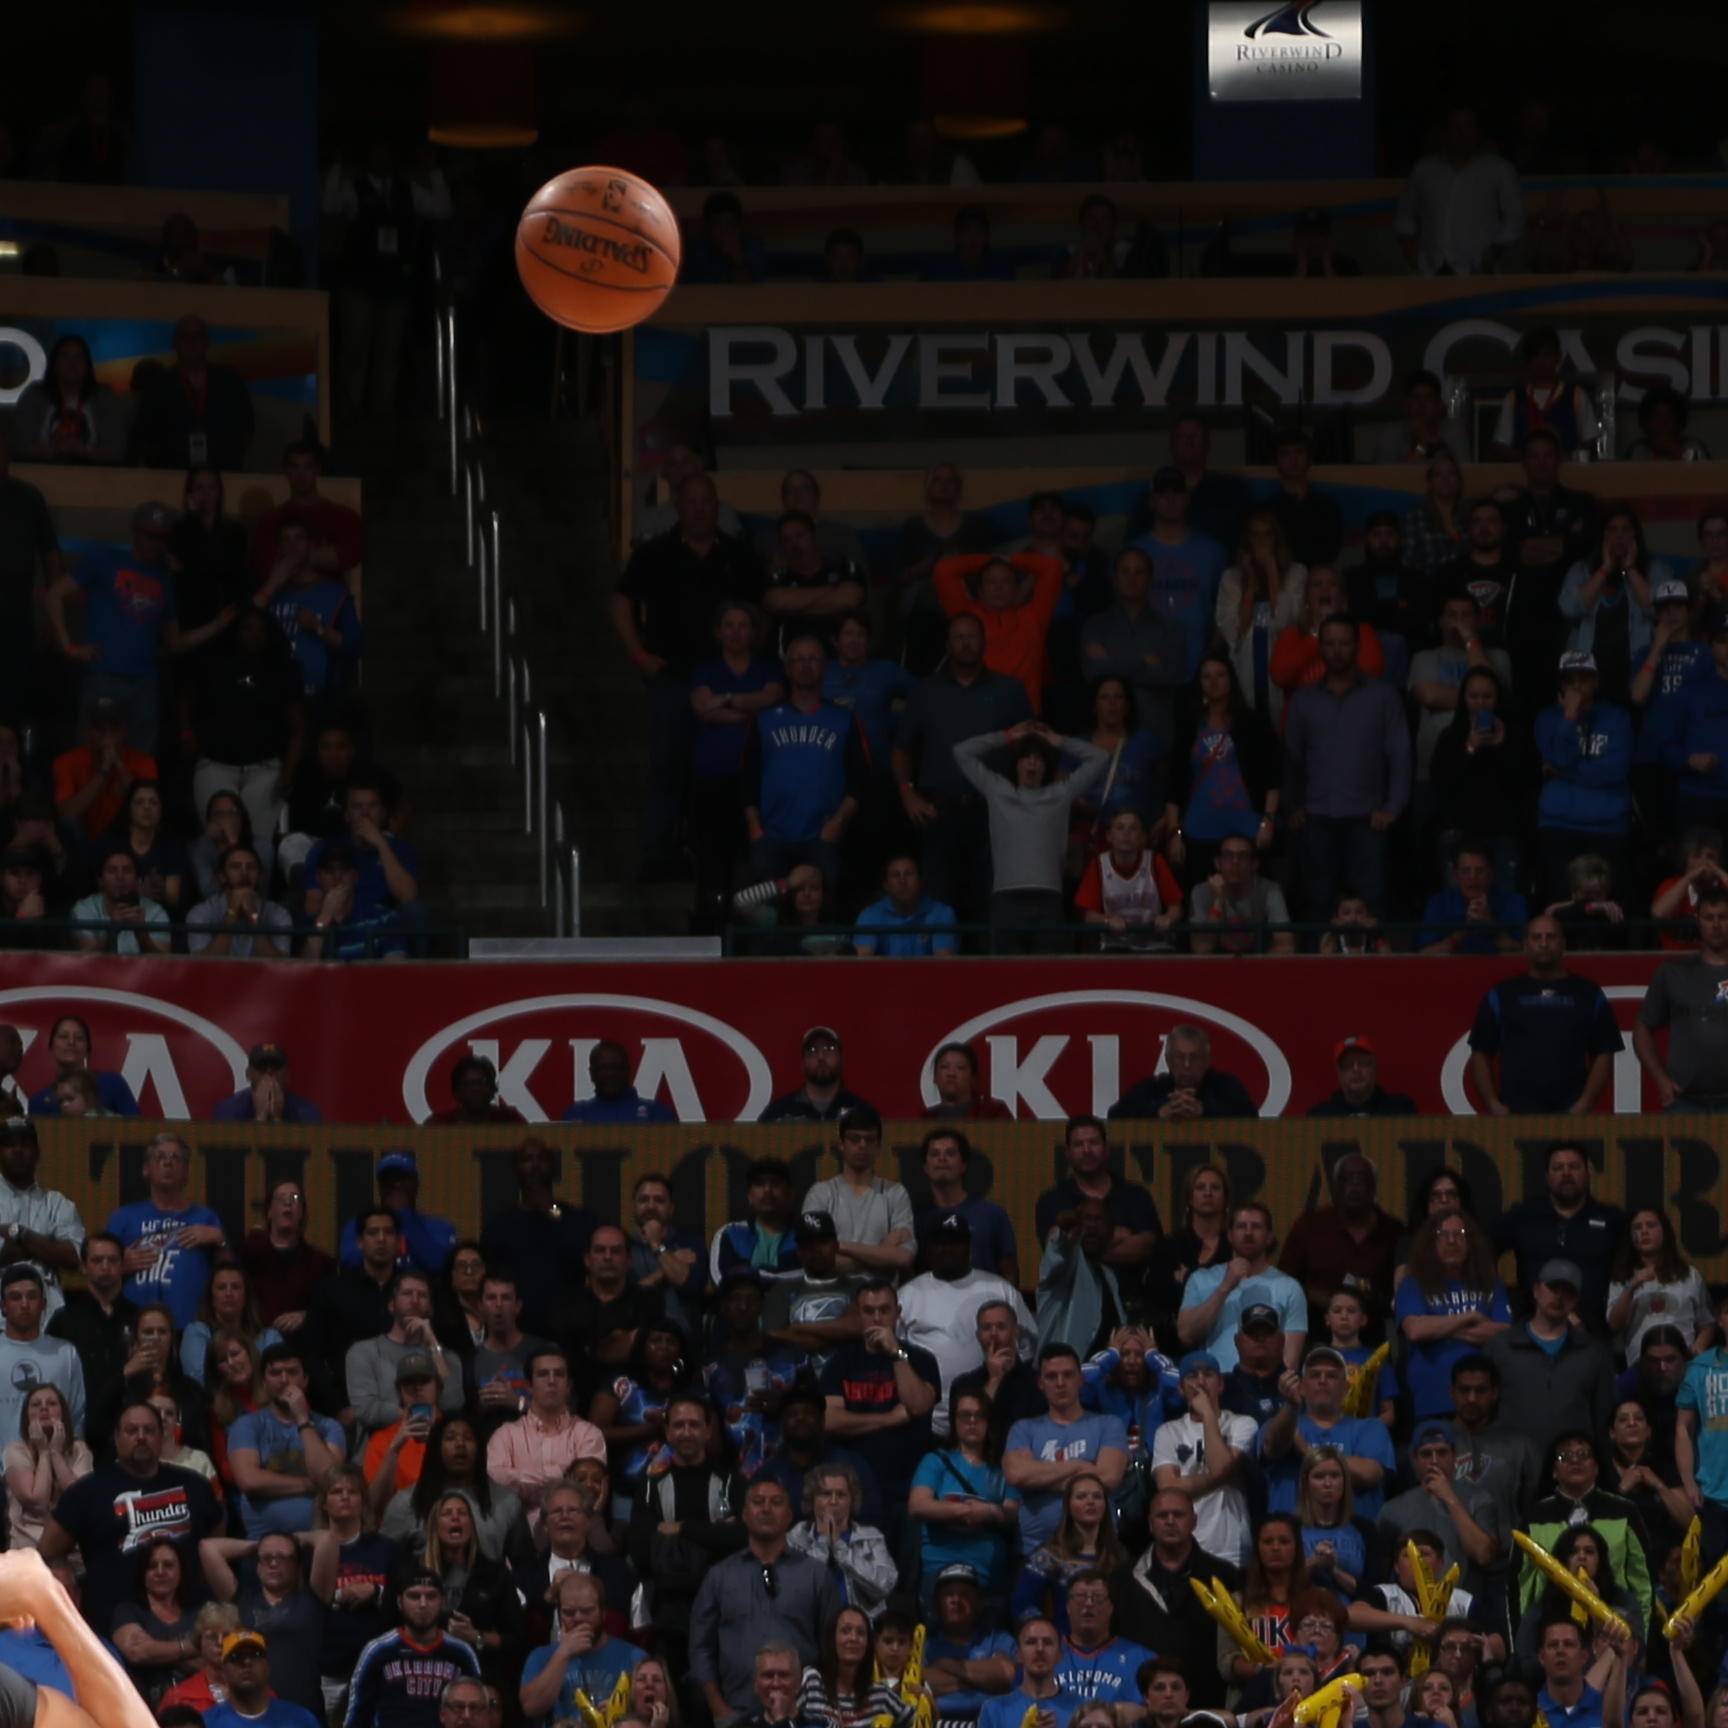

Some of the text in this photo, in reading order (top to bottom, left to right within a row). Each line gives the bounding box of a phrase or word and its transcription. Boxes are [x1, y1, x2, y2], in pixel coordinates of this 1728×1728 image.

[1235, 41, 1342, 61] RIVERWIND
[1256, 61, 1320, 75] CASINO
[707, 326, 1395, 419] RIVERWIND
[770, 724, 839, 752] THUNDER
[985, 1035, 1190, 1121] KI
